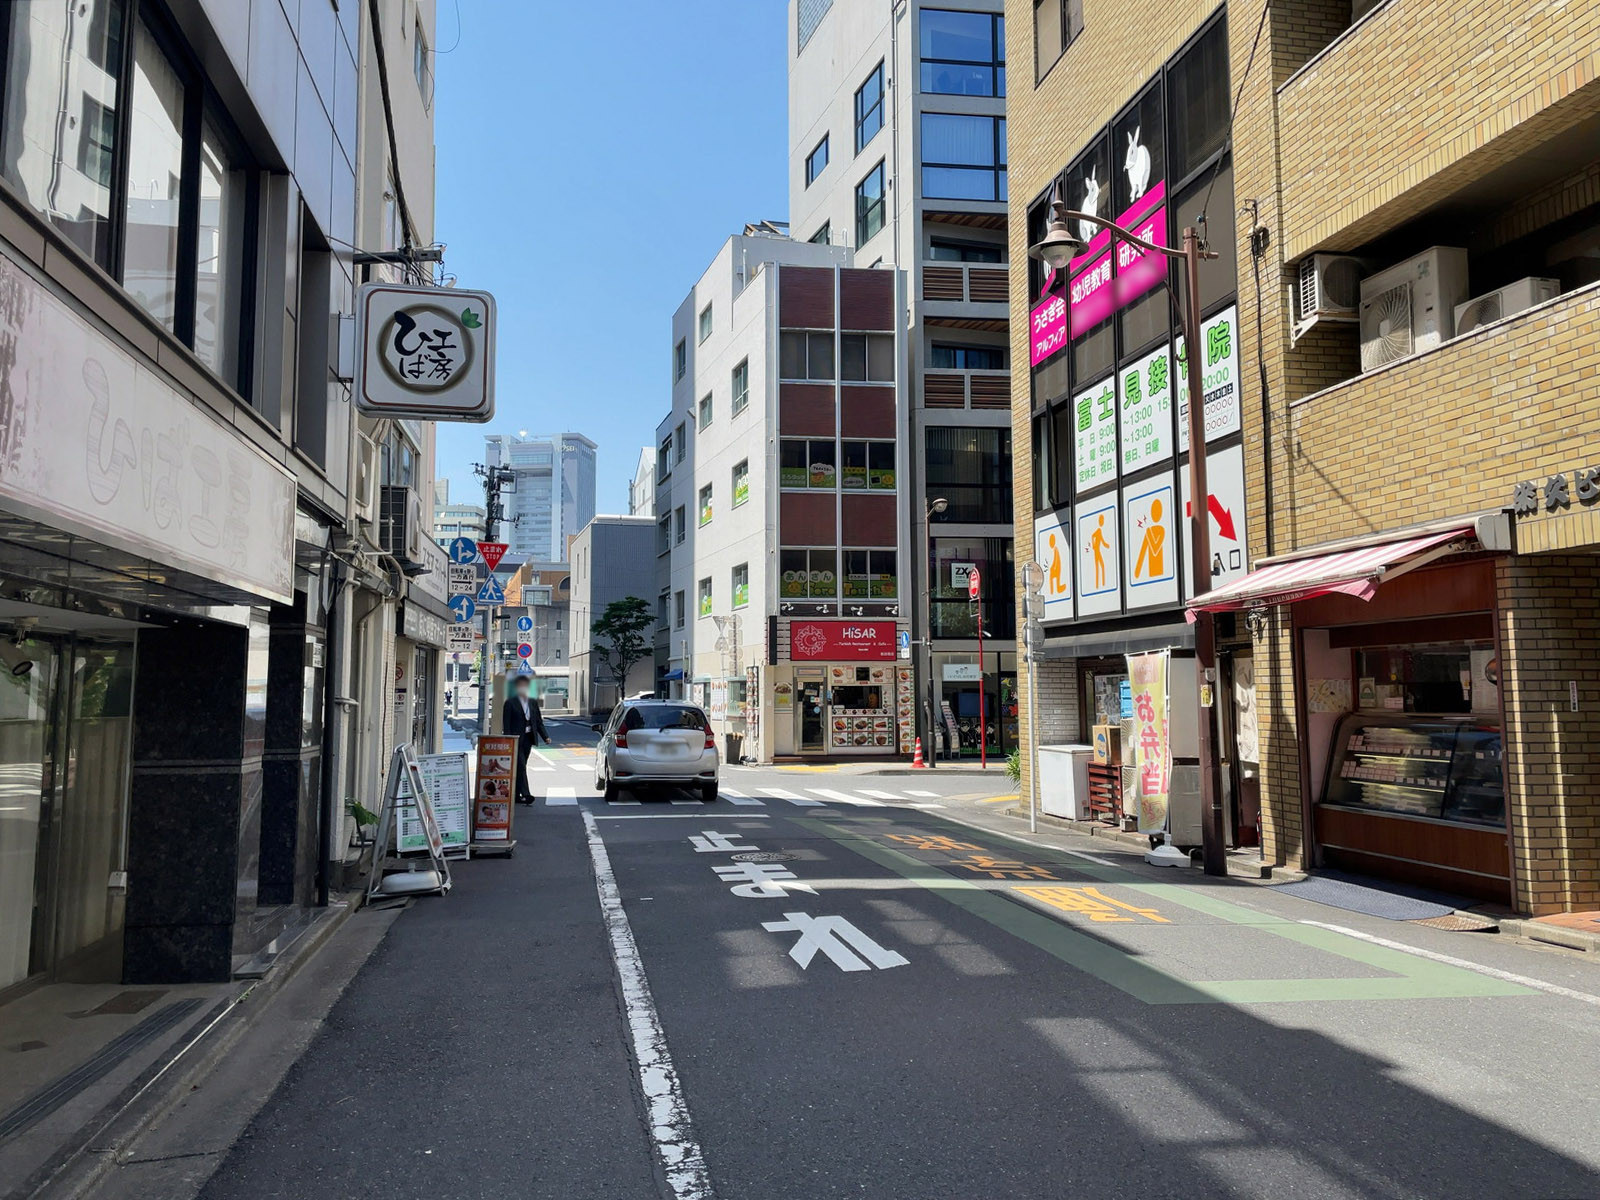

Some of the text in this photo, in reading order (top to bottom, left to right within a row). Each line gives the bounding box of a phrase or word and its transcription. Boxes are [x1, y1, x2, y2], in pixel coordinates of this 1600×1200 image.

[1034, 297, 1065, 333] うさぎ会
[1071, 258, 1111, 304] 幼児教育
[1036, 325, 1065, 358] アルフィア
[1079, 466, 1096, 483] 定休日
[842, 627, 877, 639] HiSAR
[687, 829, 911, 972] 止まれ
